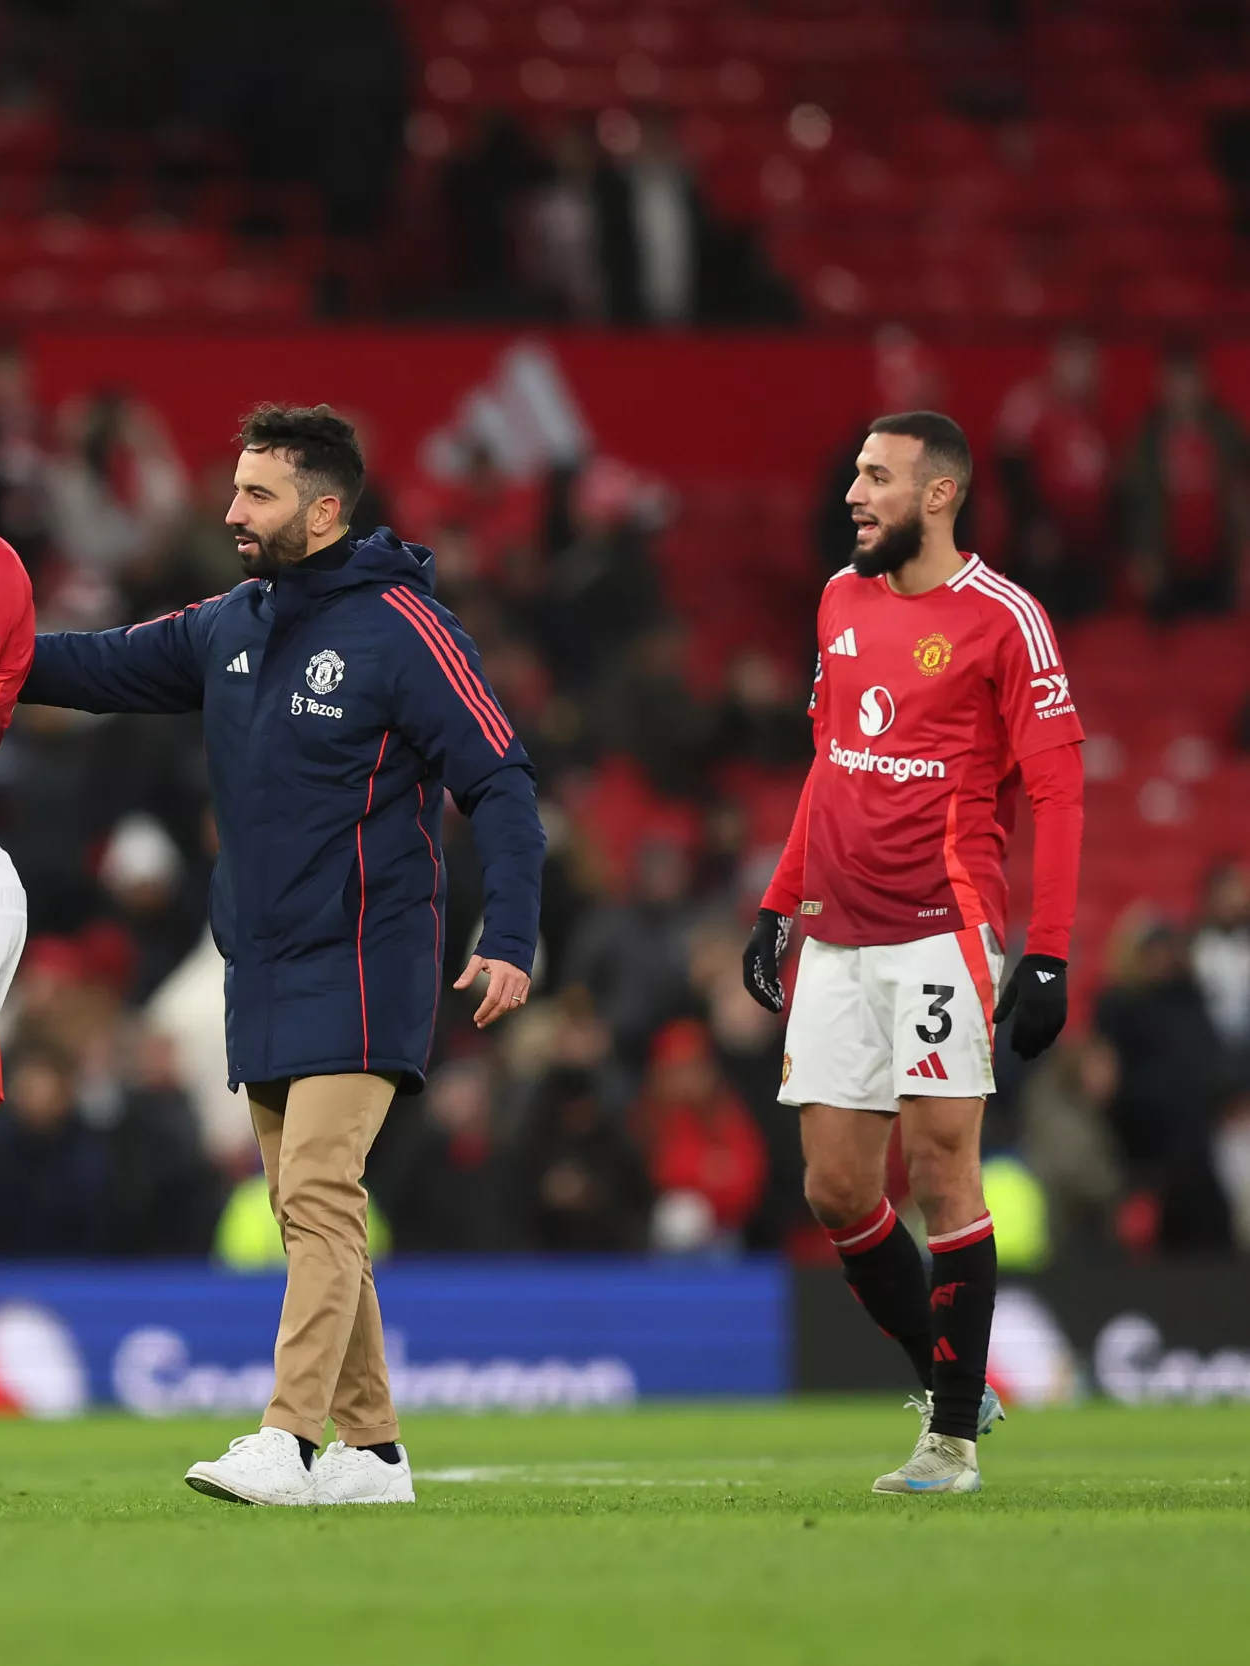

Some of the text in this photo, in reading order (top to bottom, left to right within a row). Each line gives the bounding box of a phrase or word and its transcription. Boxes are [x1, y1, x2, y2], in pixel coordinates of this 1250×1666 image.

[305, 697, 344, 719] Tezos
[1030, 673, 1069, 710] DX
[828, 738, 946, 783] Snapdragon
[915, 983, 955, 1044] 3
